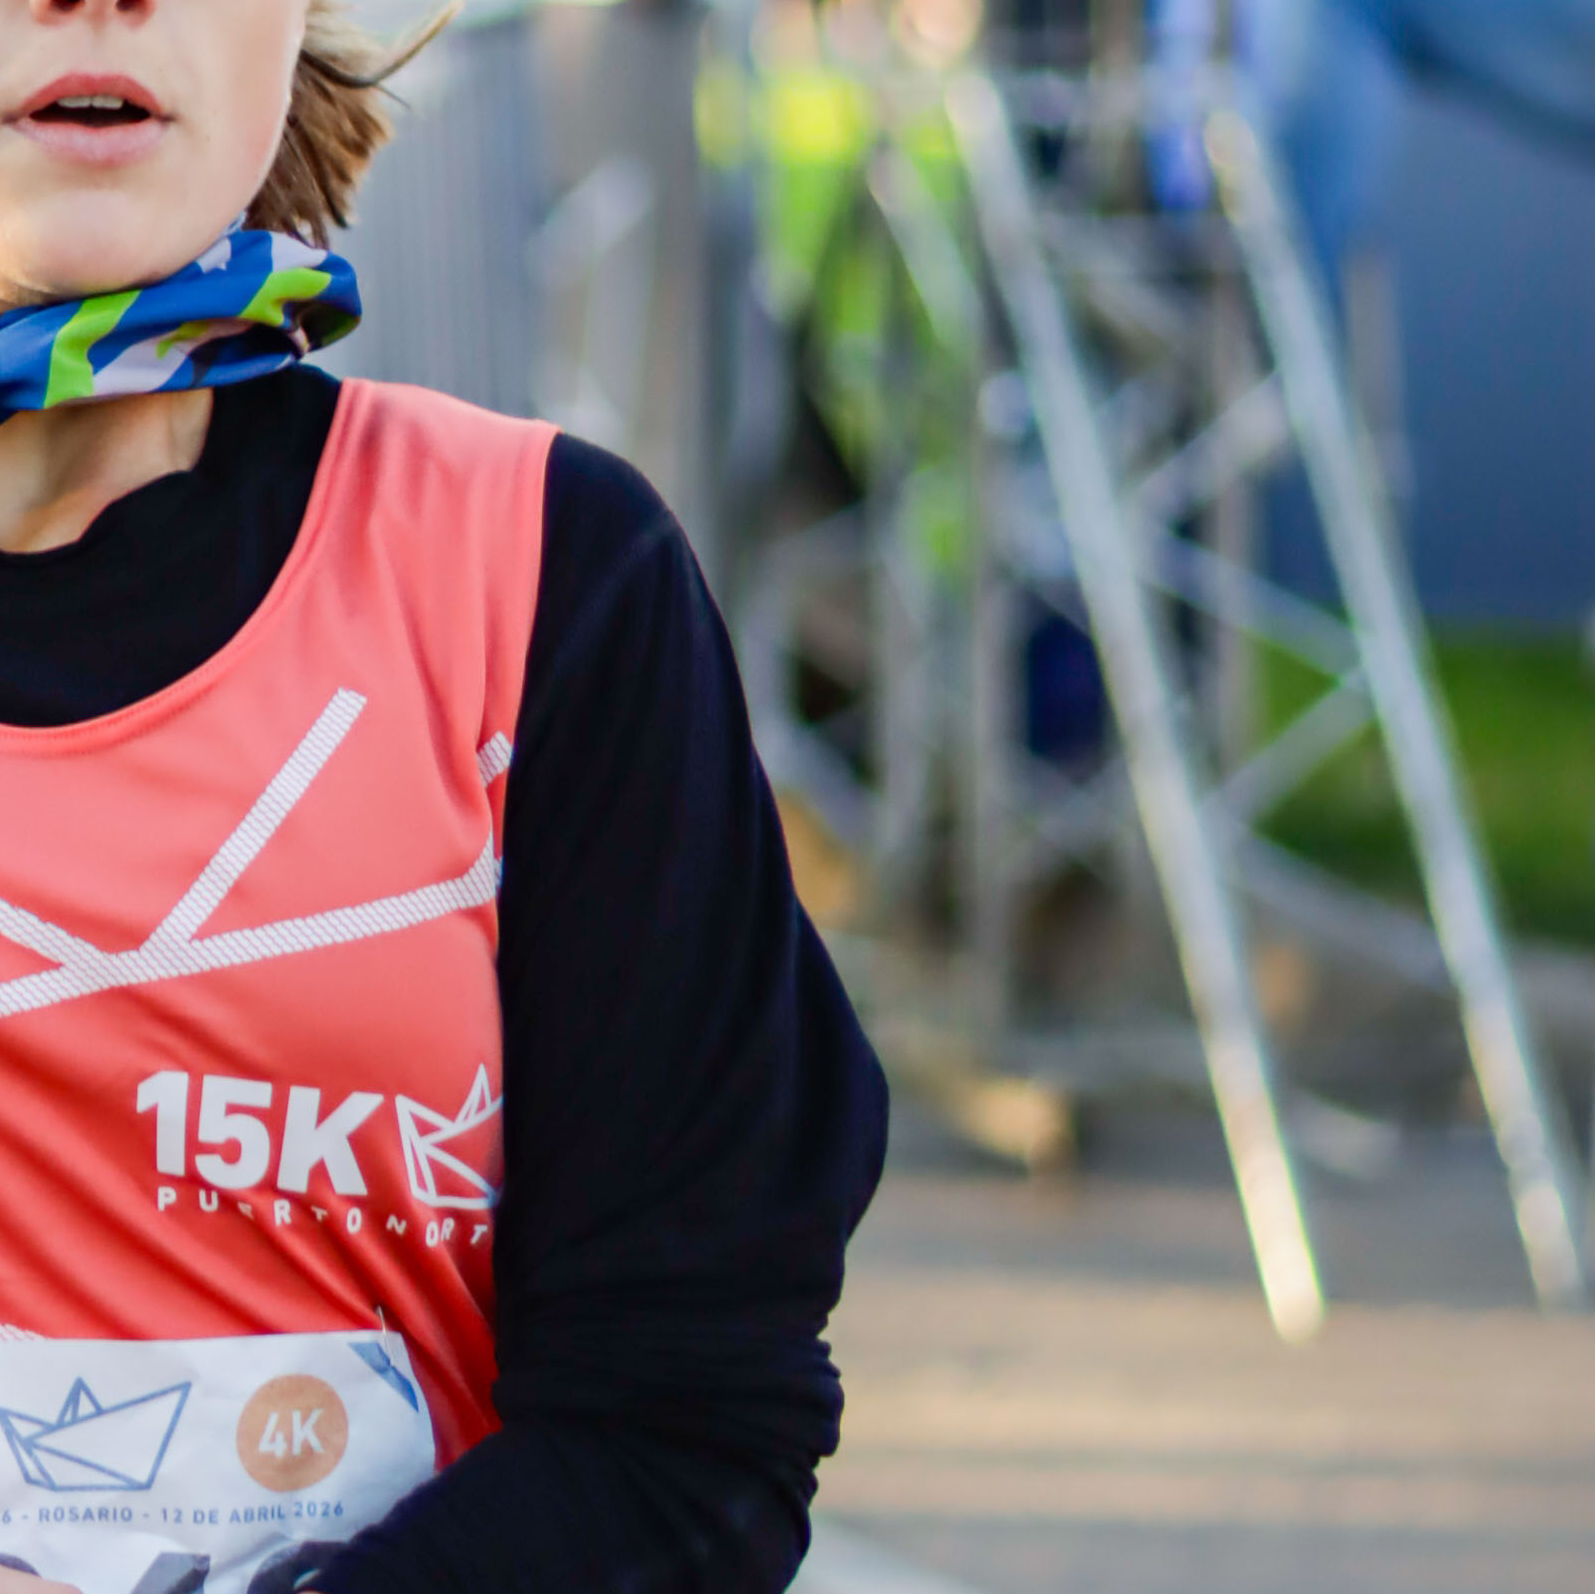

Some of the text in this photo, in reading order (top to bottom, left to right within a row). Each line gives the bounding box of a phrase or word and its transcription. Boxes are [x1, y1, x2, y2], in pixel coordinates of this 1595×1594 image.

[136, 1070, 384, 1196] 15K
[386, 1215, 488, 1247] NORT
[258, 1407, 325, 1458] 4K
[38, 1506, 133, 1523] ROSARIO
[162, 1507, 183, 1523] 12
[192, 1508, 219, 1524] DE
[229, 1505, 286, 1524] ABRIL
[293, 1501, 344, 1518] 2026
